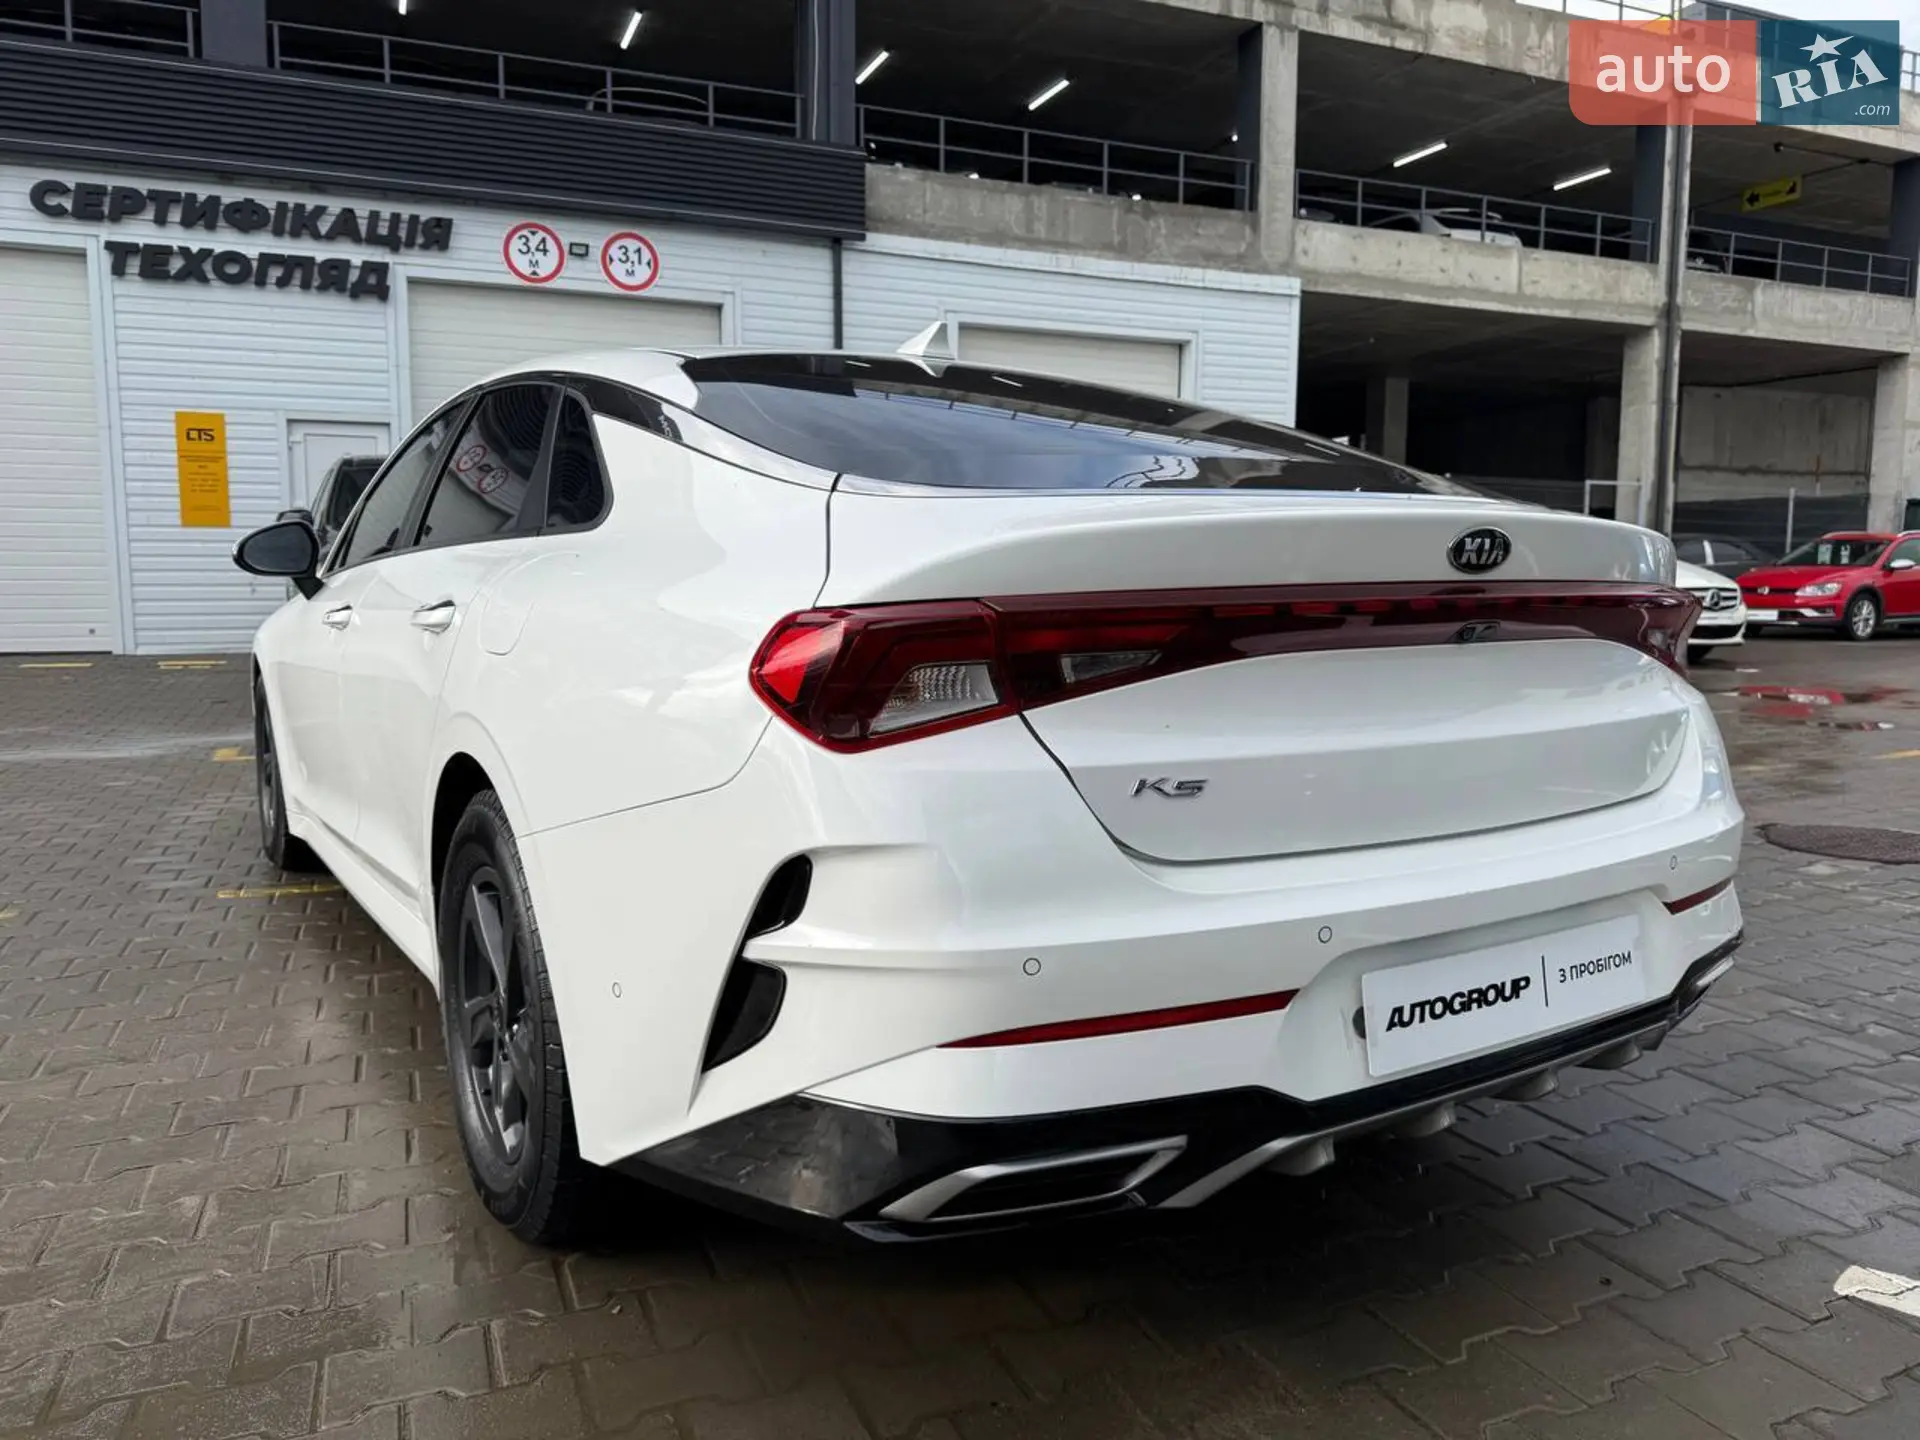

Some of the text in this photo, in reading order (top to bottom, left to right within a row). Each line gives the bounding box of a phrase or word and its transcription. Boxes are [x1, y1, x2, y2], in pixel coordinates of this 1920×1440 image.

[29, 179, 454, 252] СЕРТИФІКАЦІЯ
[517, 234, 549, 257] 3,4
[618, 244, 643, 267] 3,1
[104, 240, 391, 300] ТЕХОГЛЯД
[1460, 537, 1504, 565] KIA
[1130, 778, 1208, 798] K5
[1569, 950, 1632, 981] ПРОБІГОМ
[1386, 976, 1531, 1032] AUTOGROUP
